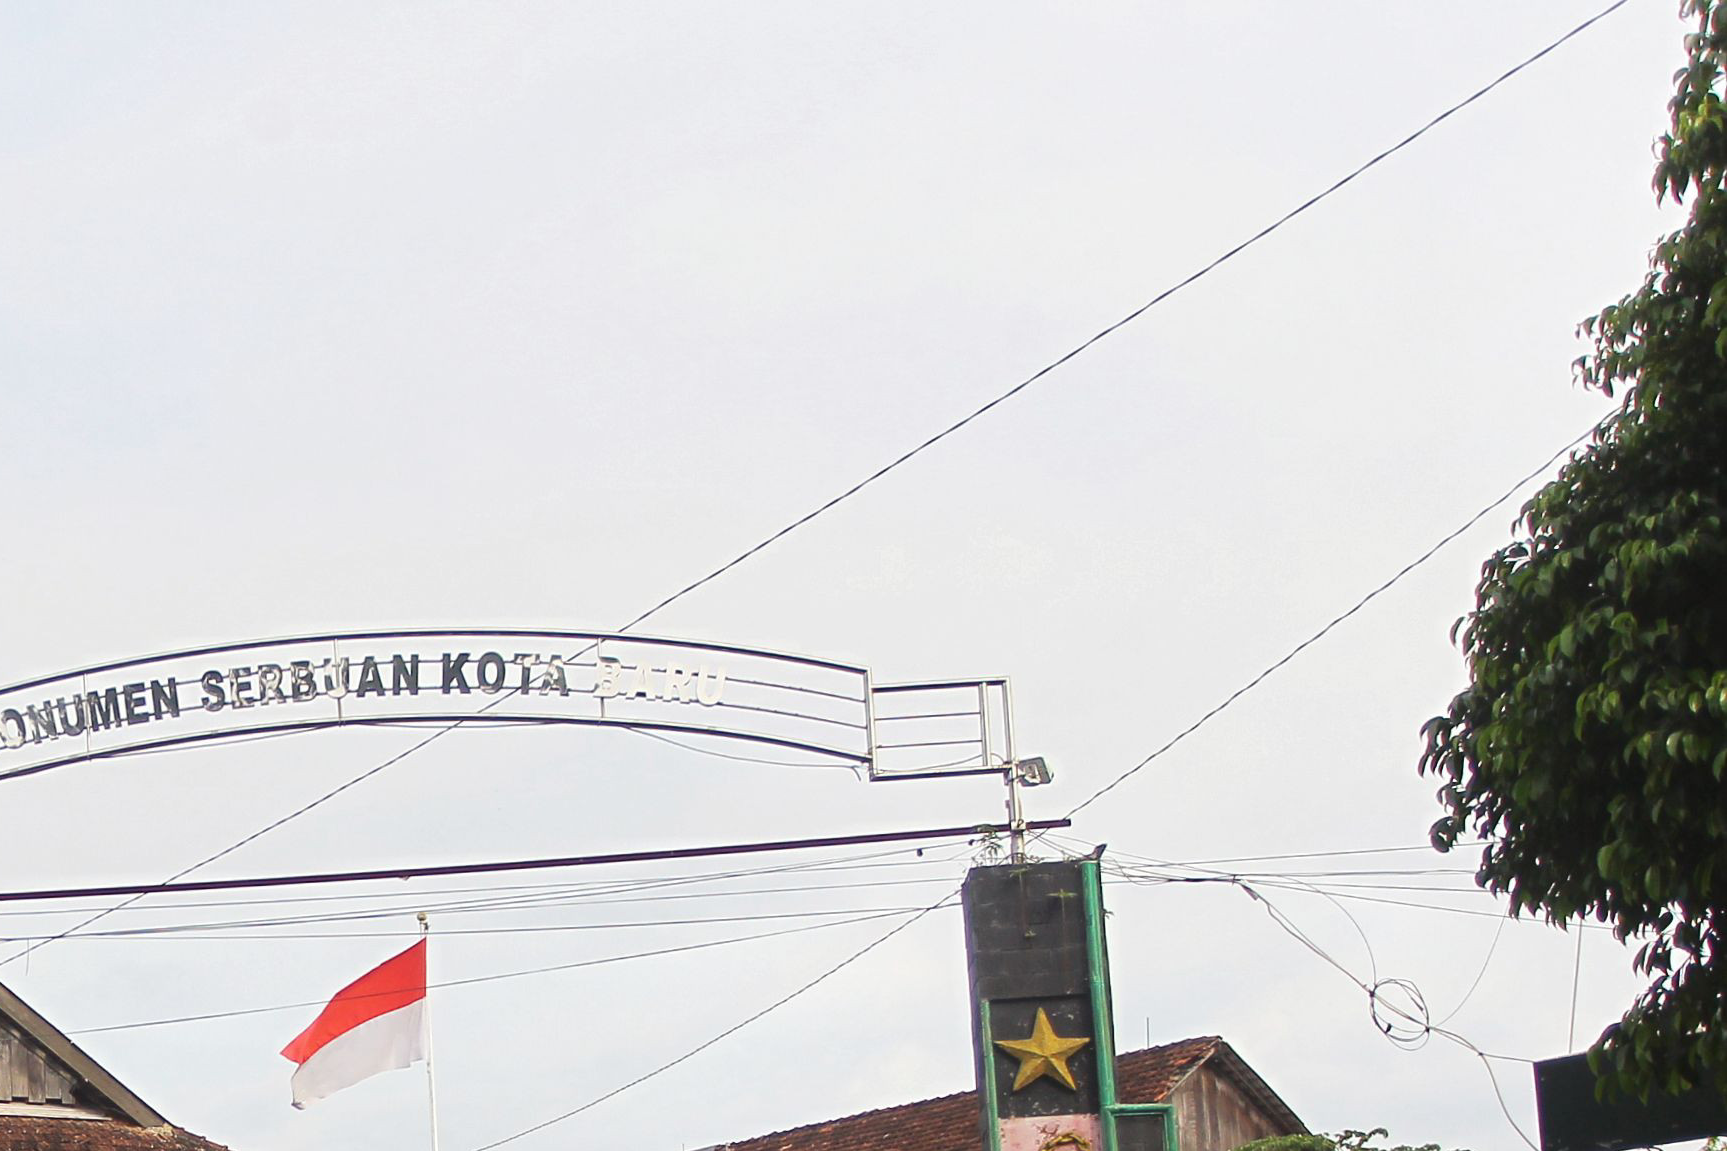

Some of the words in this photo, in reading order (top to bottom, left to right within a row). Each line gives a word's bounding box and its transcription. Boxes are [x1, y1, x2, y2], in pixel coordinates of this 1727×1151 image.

[201, 654, 420, 712] SERBUAN
[441, 651, 570, 697] KOTA
[592, 656, 727, 707] BARU
